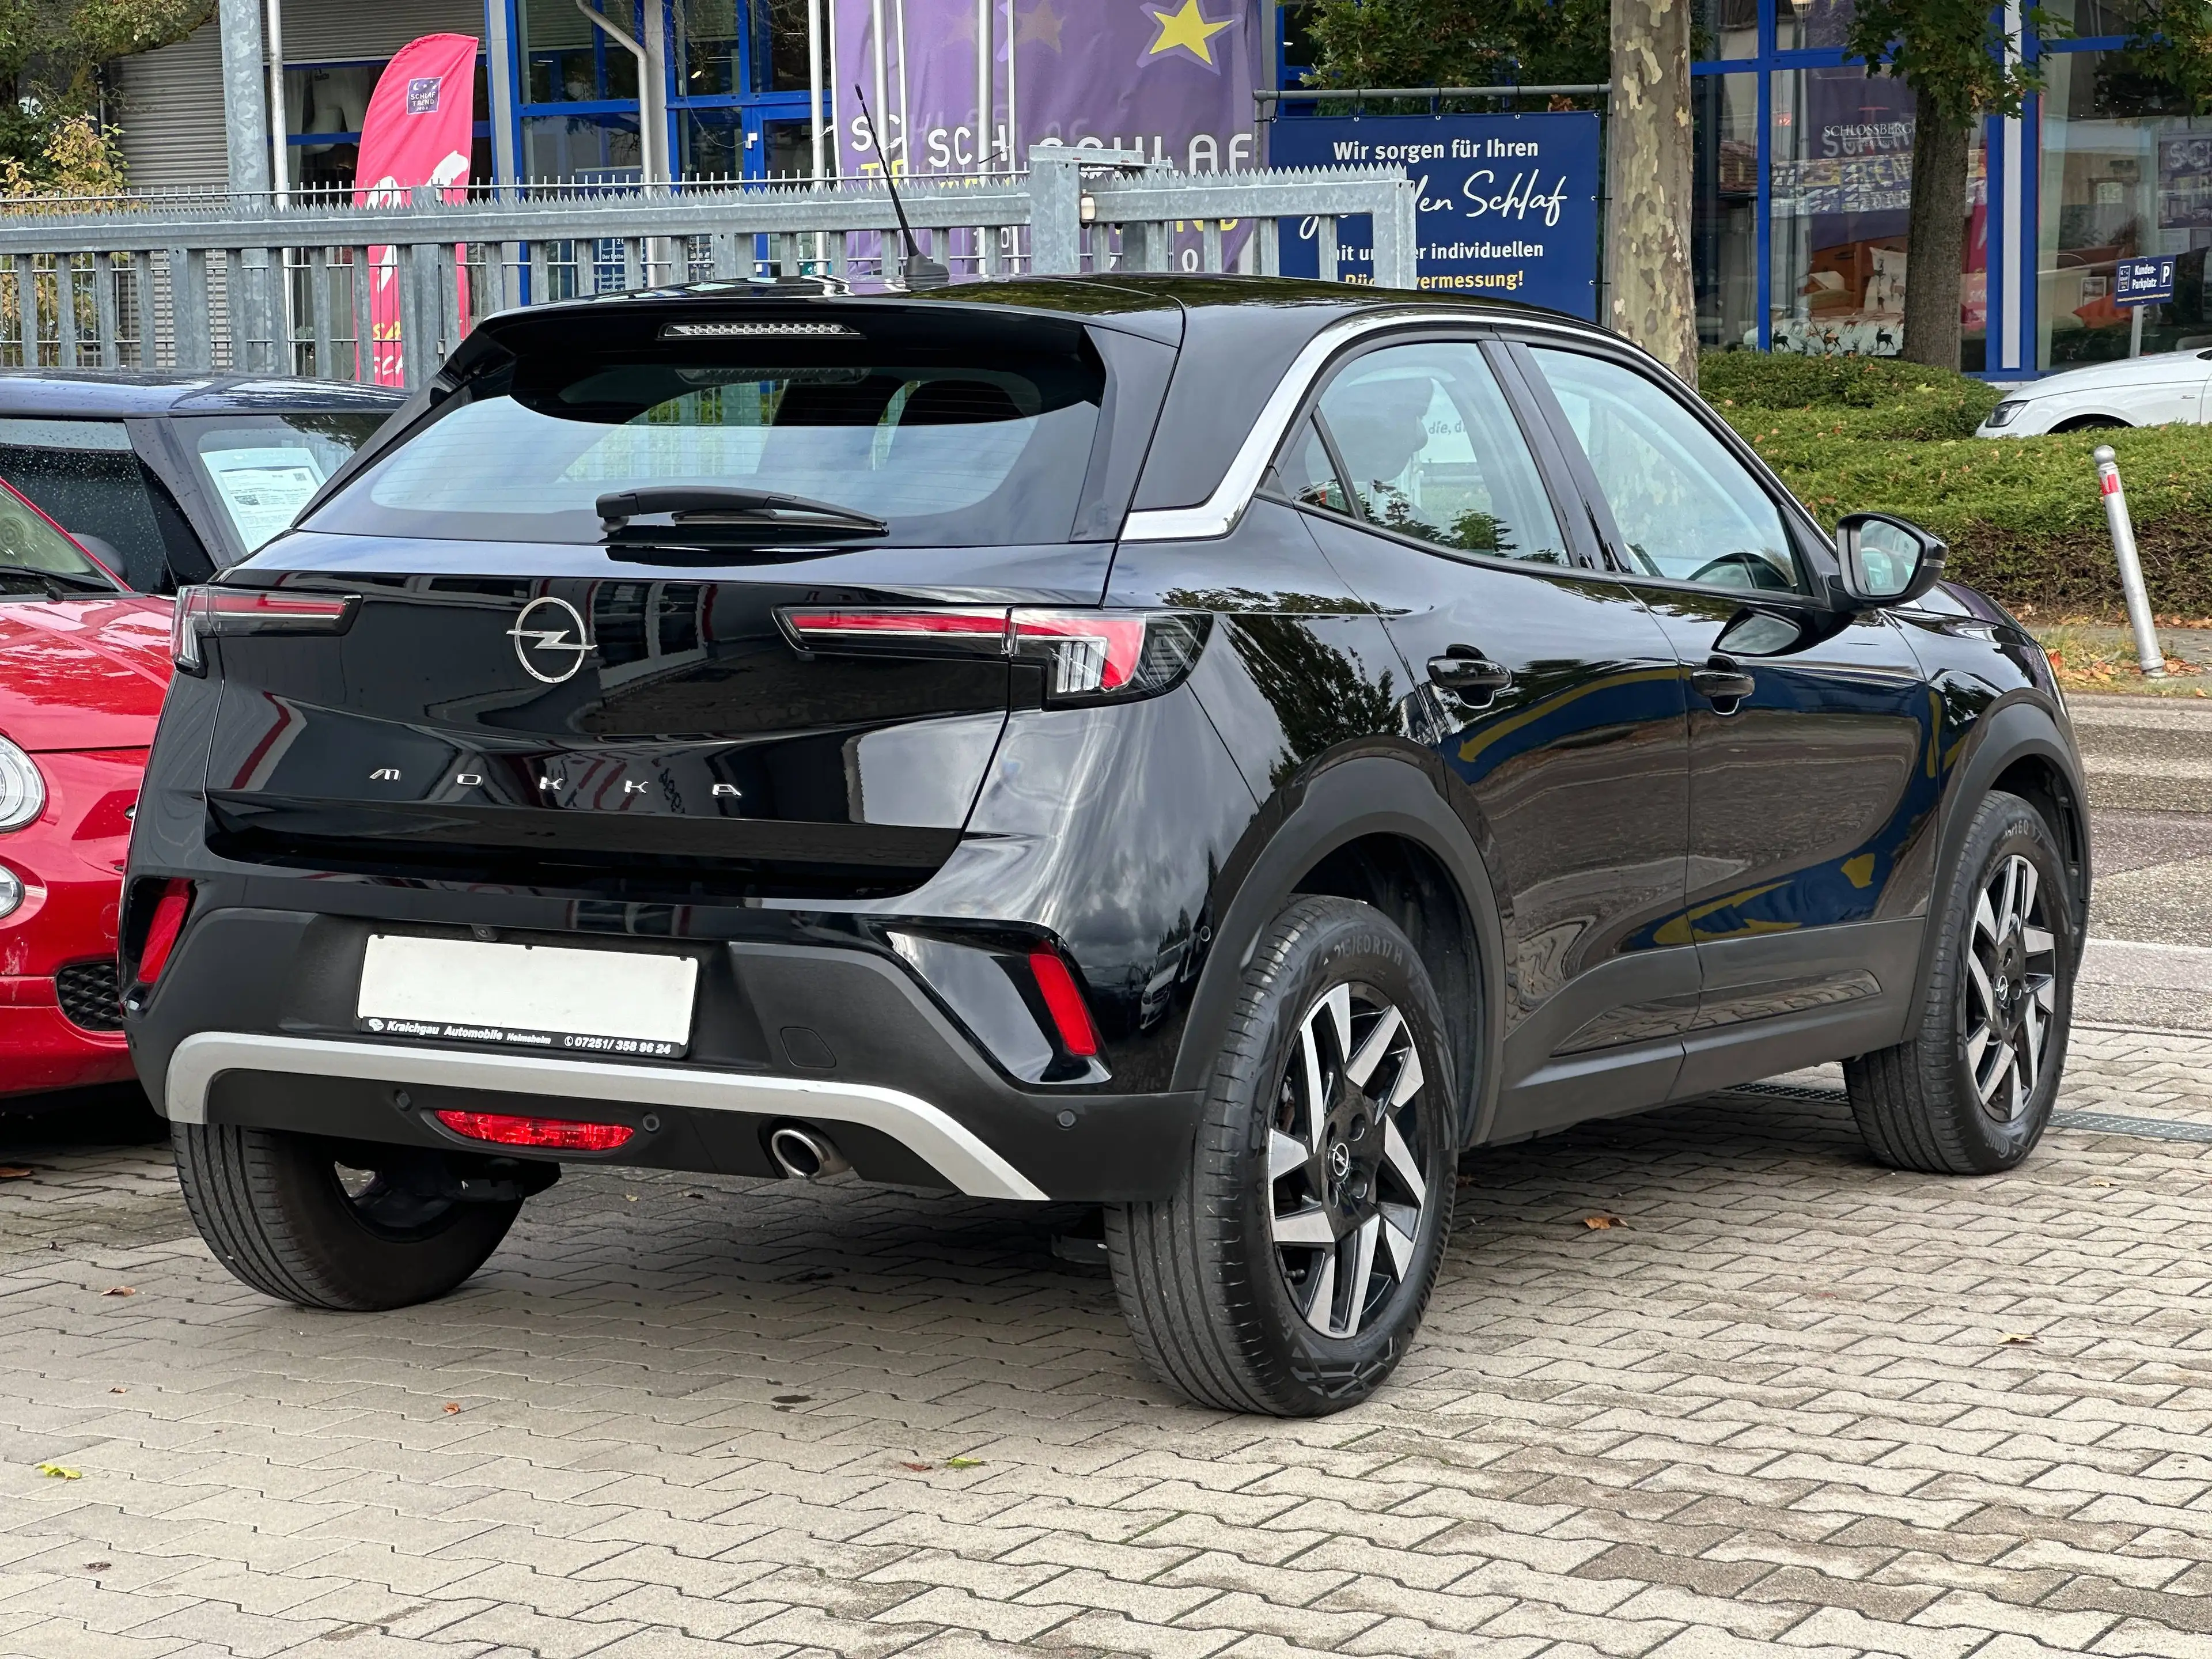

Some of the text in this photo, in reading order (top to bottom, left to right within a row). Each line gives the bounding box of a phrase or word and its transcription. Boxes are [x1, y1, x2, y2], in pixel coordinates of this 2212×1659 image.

[1333, 138, 1539, 164] Wir sorgen für Ihren
[1463, 168, 1567, 226] Schlaf
[1431, 241, 1543, 259] individuellen
[2132, 277, 2157, 291] Parkplatz
[2134, 264, 2171, 283] Kunden- P
[369, 768, 743, 797] MOKKA
[387, 1021, 440, 1036] Kraichgau
[444, 1025, 503, 1040] Automobile
[639, 1042, 654, 1054] 96
[656, 1044, 672, 1055] 24
